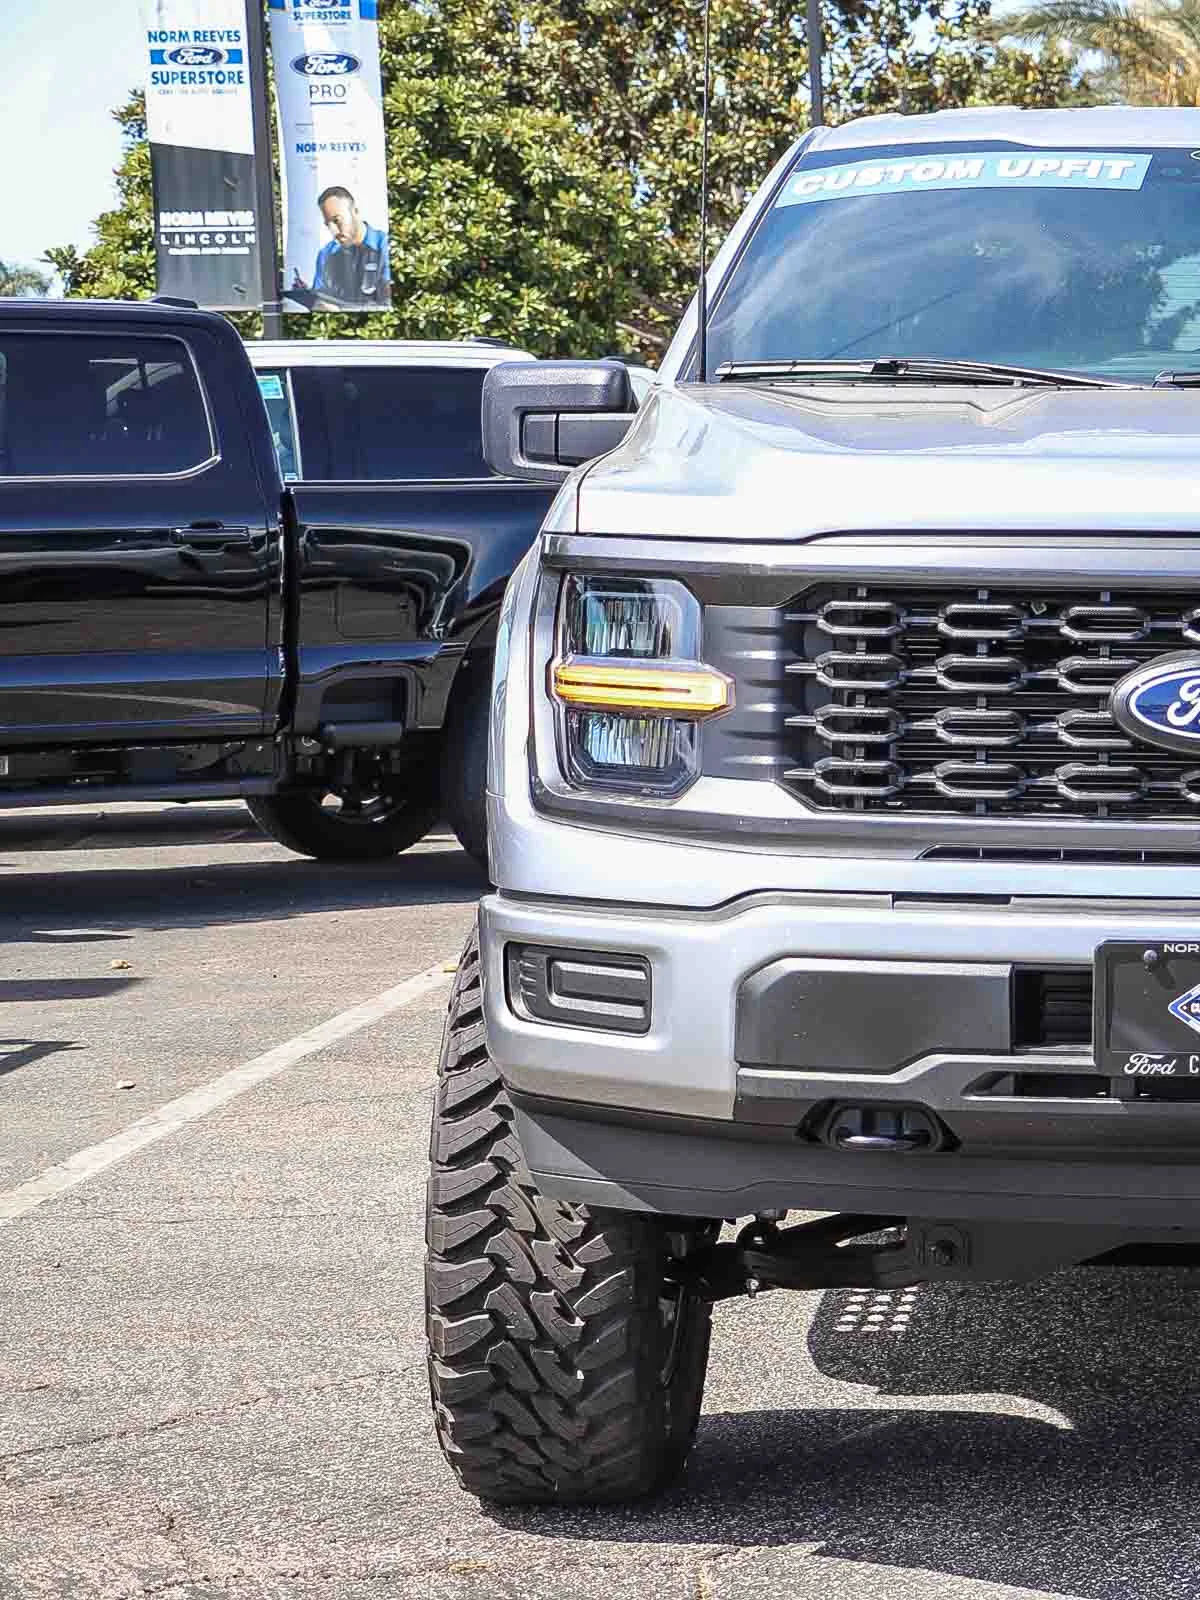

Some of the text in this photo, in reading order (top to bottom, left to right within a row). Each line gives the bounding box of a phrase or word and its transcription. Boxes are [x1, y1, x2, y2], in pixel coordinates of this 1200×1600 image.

[148, 30, 241, 43] NORM REEVES
[177, 48, 214, 64] Ford
[304, 55, 349, 75] Ford
[151, 70, 245, 85] SUPERSTORE
[309, 84, 346, 98] PRO
[793, 158, 1137, 196] CUSTOM UPFIT
[160, 233, 256, 245] LINCOLN
[1123, 1052, 1177, 1075] Ford
